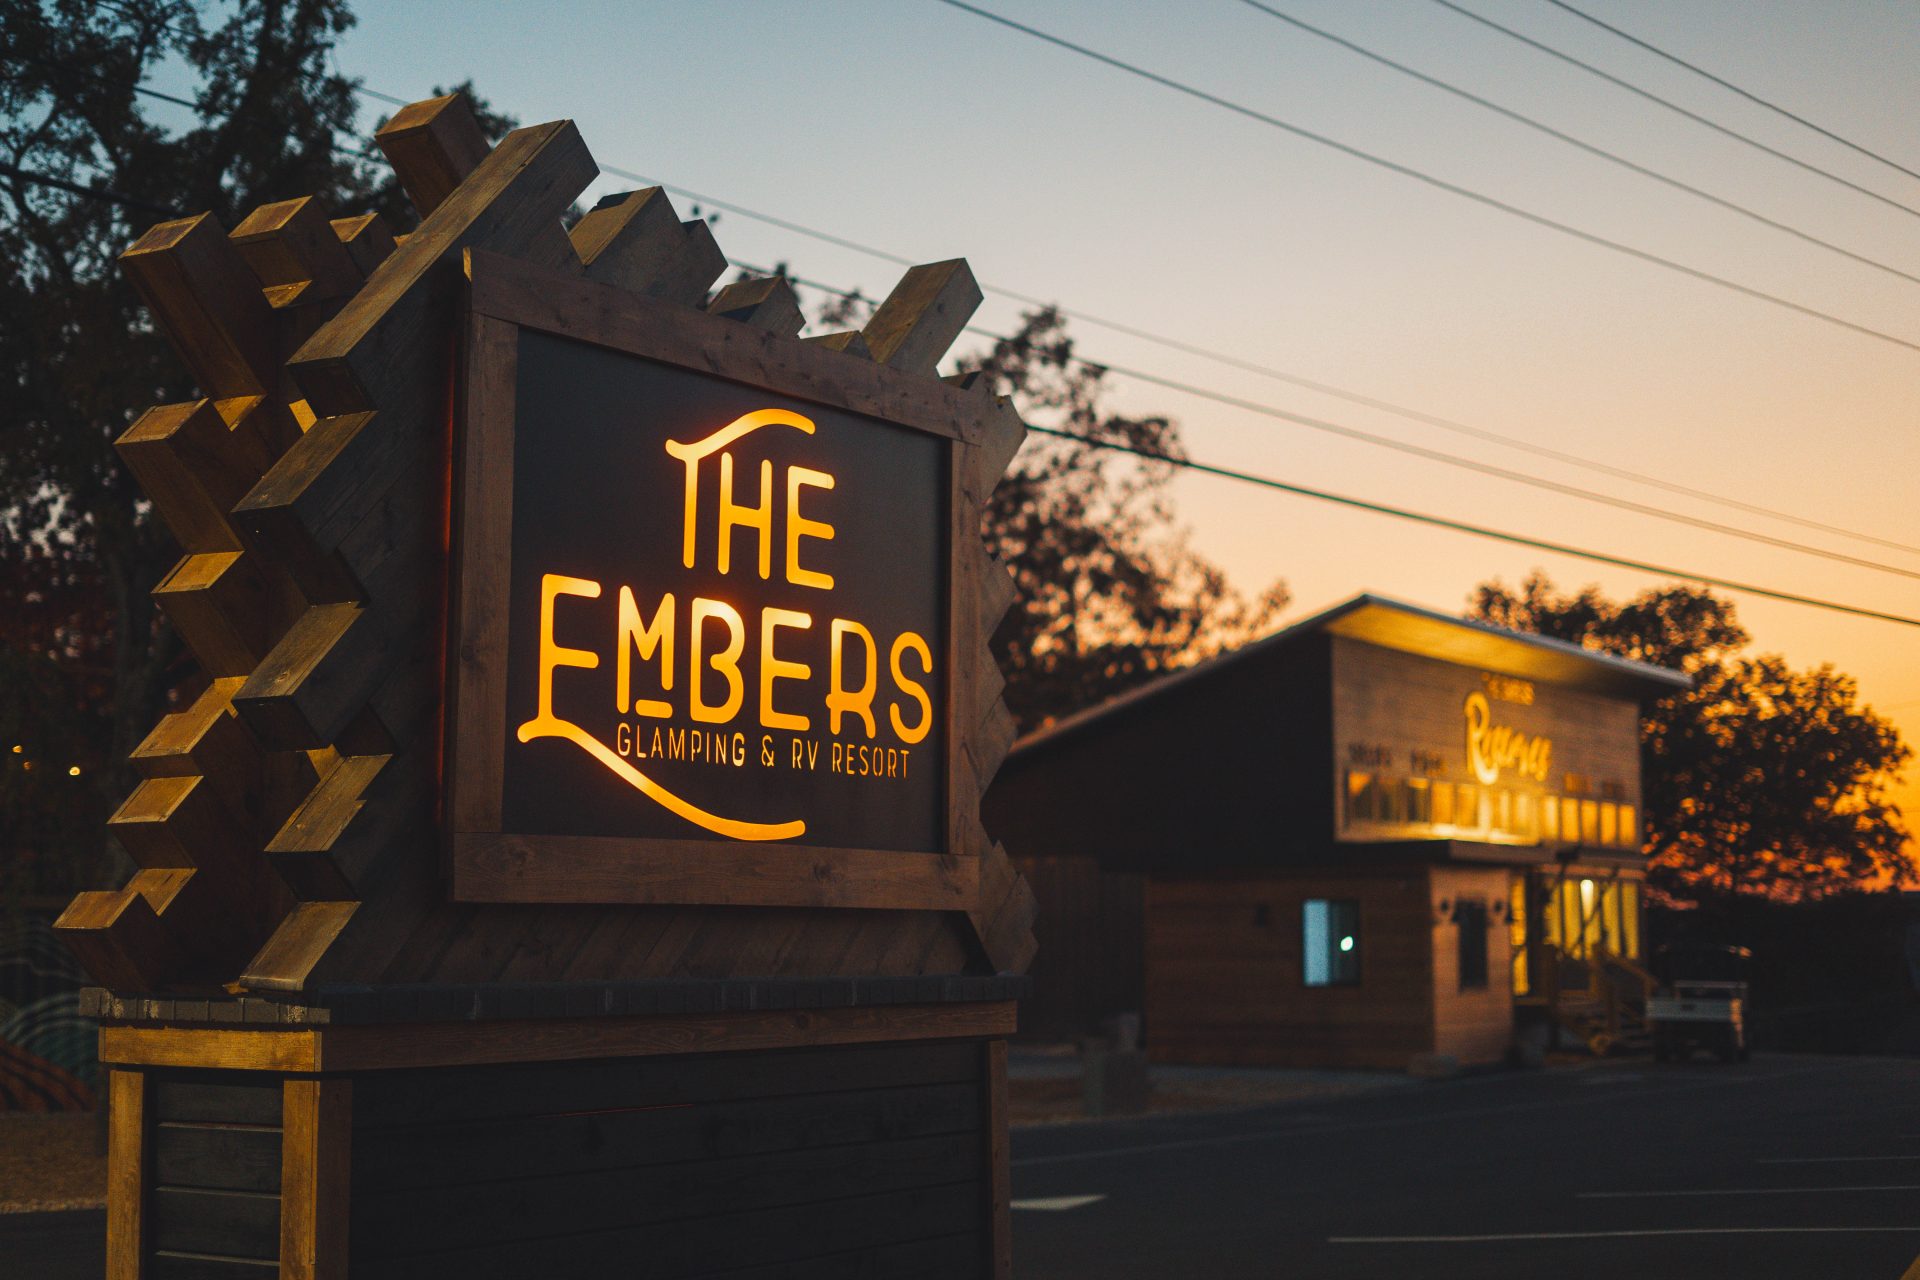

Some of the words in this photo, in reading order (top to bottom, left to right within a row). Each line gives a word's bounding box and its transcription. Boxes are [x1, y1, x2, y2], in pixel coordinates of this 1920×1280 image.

[665, 408, 835, 590] THE
[517, 573, 933, 841] EMBERS
[617, 722, 745, 767] GLAMPING
[761, 734, 775, 767] &
[792, 738, 819, 770] RV
[832, 742, 909, 778] RESORT
